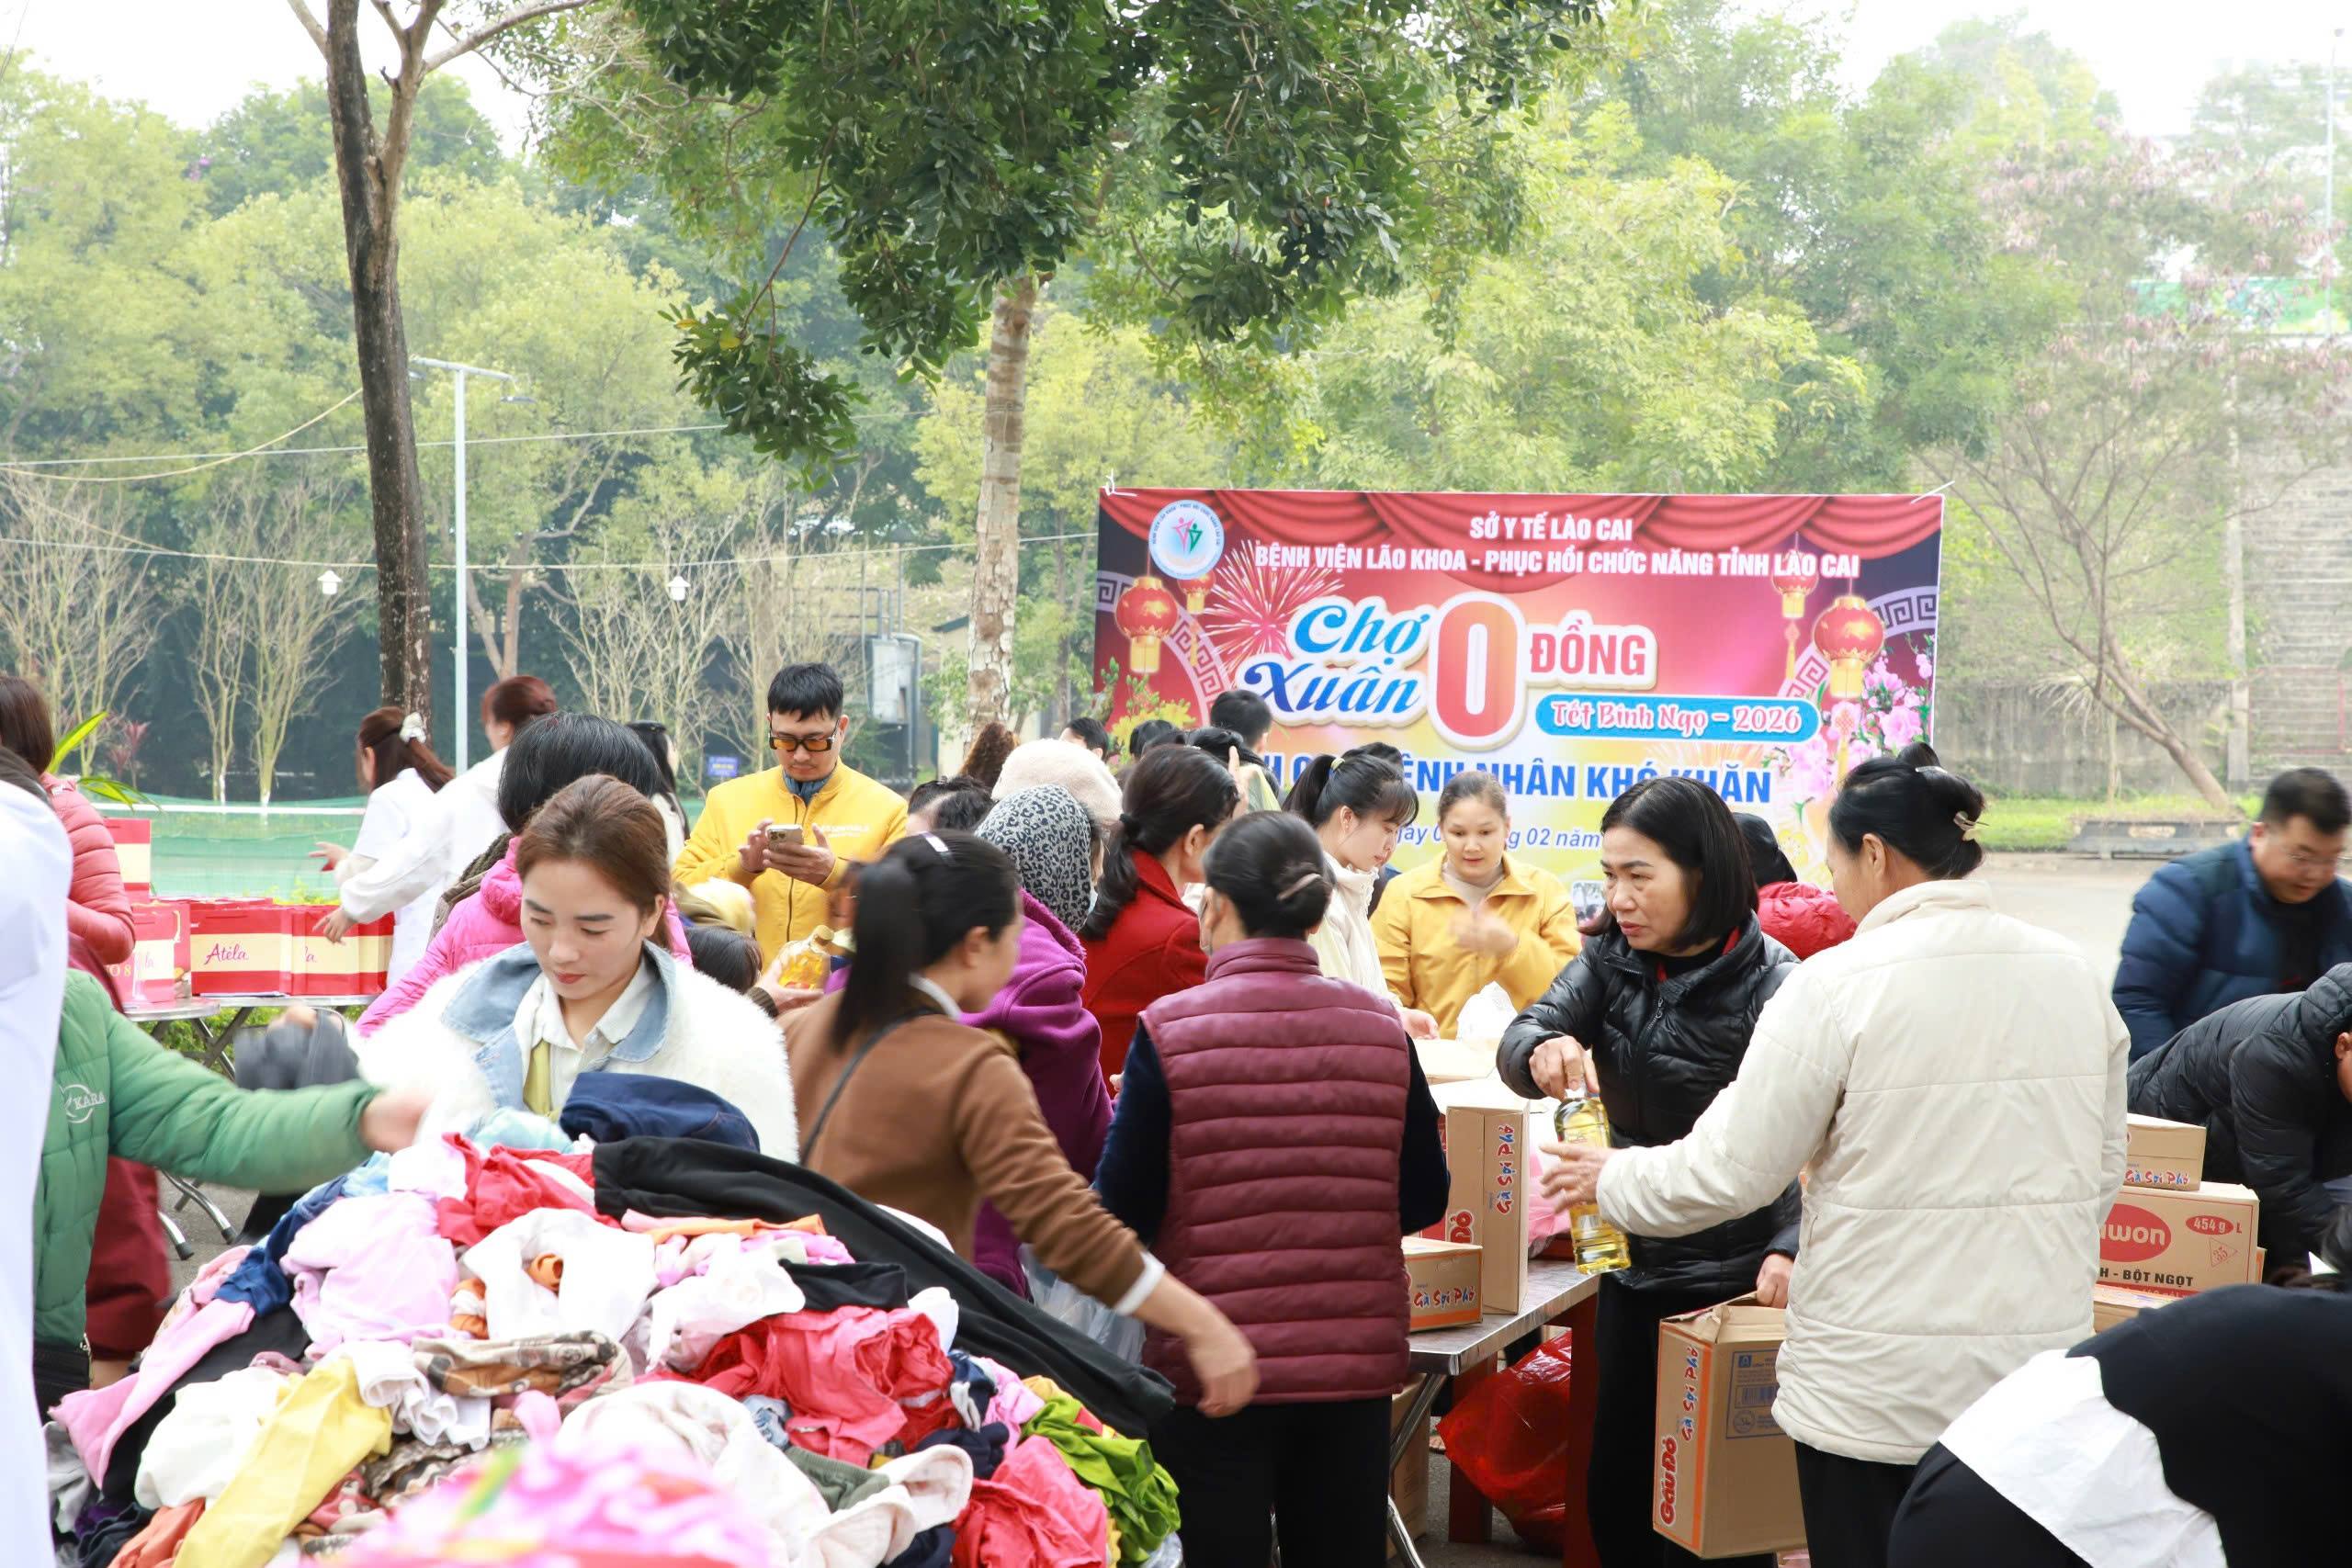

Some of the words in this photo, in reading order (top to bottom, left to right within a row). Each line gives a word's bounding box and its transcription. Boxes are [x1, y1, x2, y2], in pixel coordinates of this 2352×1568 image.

[1470, 511, 1499, 539] SỞ
[1504, 517, 1517, 539] Y
[1521, 512, 1548, 539] TẾ
[1551, 514, 1591, 540] LÀO
[1597, 519, 1632, 540] CAI
[1255, 542, 1311, 570] BỆNH
[1315, 544, 1362, 572] VIỆN
[1366, 545, 1406, 570] LÃO
[1411, 548, 1467, 571] KHOA
[1485, 550, 1543, 577] PHỤC
[1547, 545, 1583, 573] HỒI
[1589, 548, 1646, 573] CHỨC
[1651, 547, 1713, 575] NĂNG
[1718, 546, 1770, 576] TỈNH
[1774, 549, 1816, 577] LÀO
[1821, 554, 1860, 578] CAI
[1295, 604, 1430, 665] Chợ
[1530, 619, 1645, 675] ĐỒNG
[1436, 601, 1518, 737] 0
[1244, 661, 1421, 713] Xuân
[1552, 700, 1594, 728] Tết
[1658, 705, 1707, 736] Ngọ
[1734, 706, 1801, 732] 2026
[1670, 763, 1771, 803] HĂN
[1527, 828, 1550, 845] 02
[1555, 829, 1600, 847] năm
[1497, 1125, 1514, 1156] Phở
[1498, 1162, 1516, 1186] Sợi
[1497, 1191, 1513, 1214] Gà
[2194, 1218, 2216, 1231] 454
[2219, 1222, 2226, 1235] g
[2122, 1269, 2151, 1283] BỘT
[2154, 1273, 2194, 1288] NGỌT
[1414, 1292, 1430, 1308] Gà
